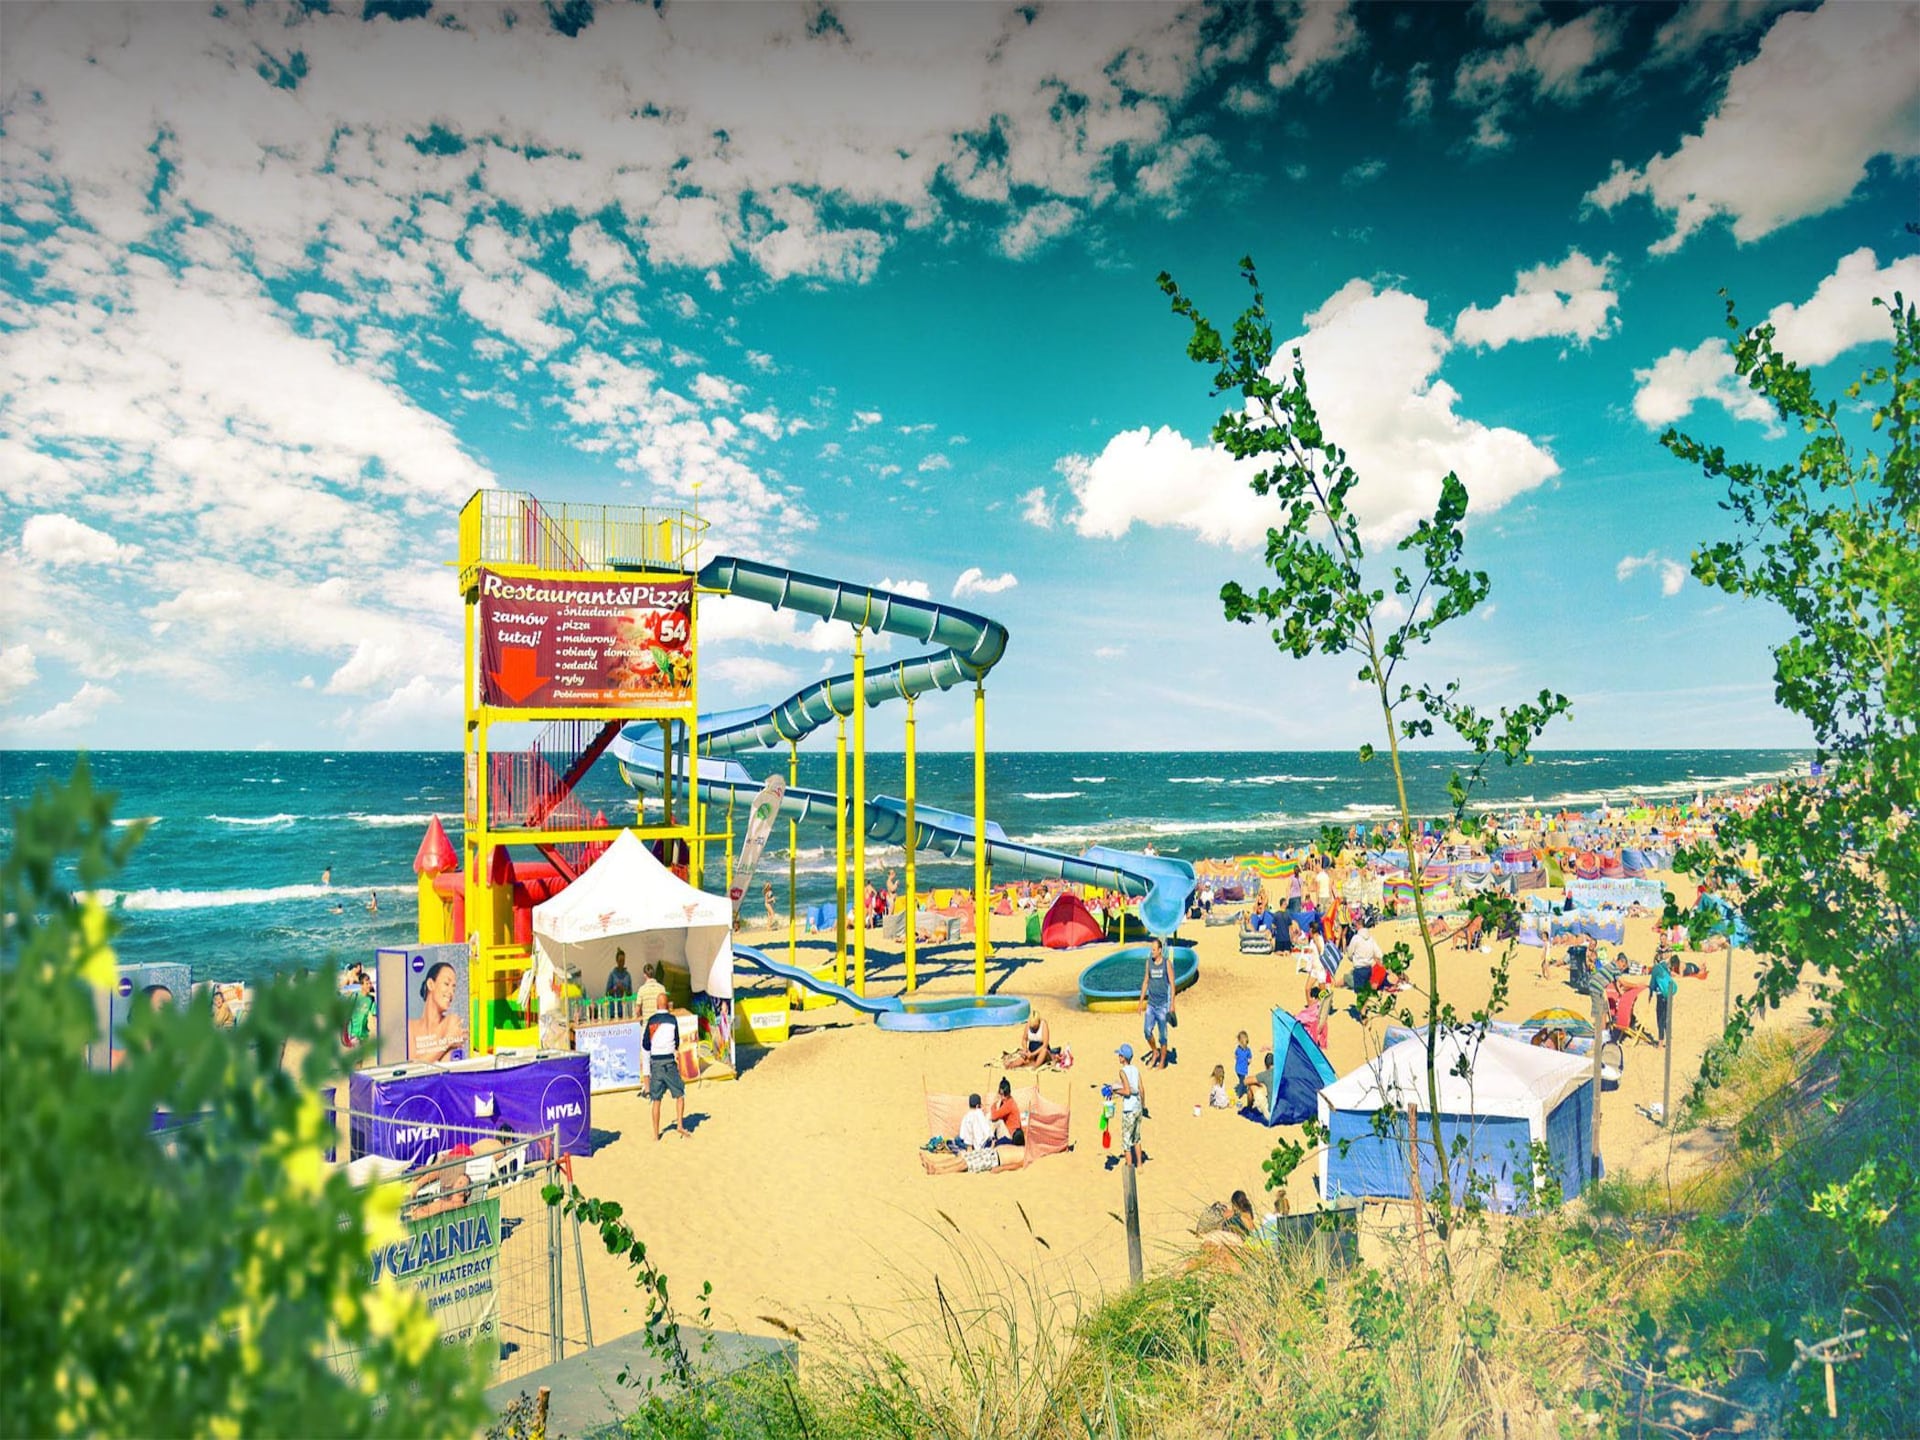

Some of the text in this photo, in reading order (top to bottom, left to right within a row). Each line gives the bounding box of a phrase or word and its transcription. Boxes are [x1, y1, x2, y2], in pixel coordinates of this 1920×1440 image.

[483, 574, 690, 607] Restaurant&Pizza
[492, 610, 548, 626] zamów
[562, 619, 591, 633] pizza
[498, 630, 543, 647] tutaj!
[660, 619, 687, 643] 54
[562, 633, 618, 647] makarony
[562, 646, 598, 660] obiady
[561, 674, 585, 687] ryby
[546, 1101, 582, 1121] NIVEA
[395, 1127, 440, 1146] NIVEA
[370, 1213, 493, 1285] YCZALNIA
[439, 1256, 492, 1286] MATERACY
[454, 1287, 467, 1300] DO
